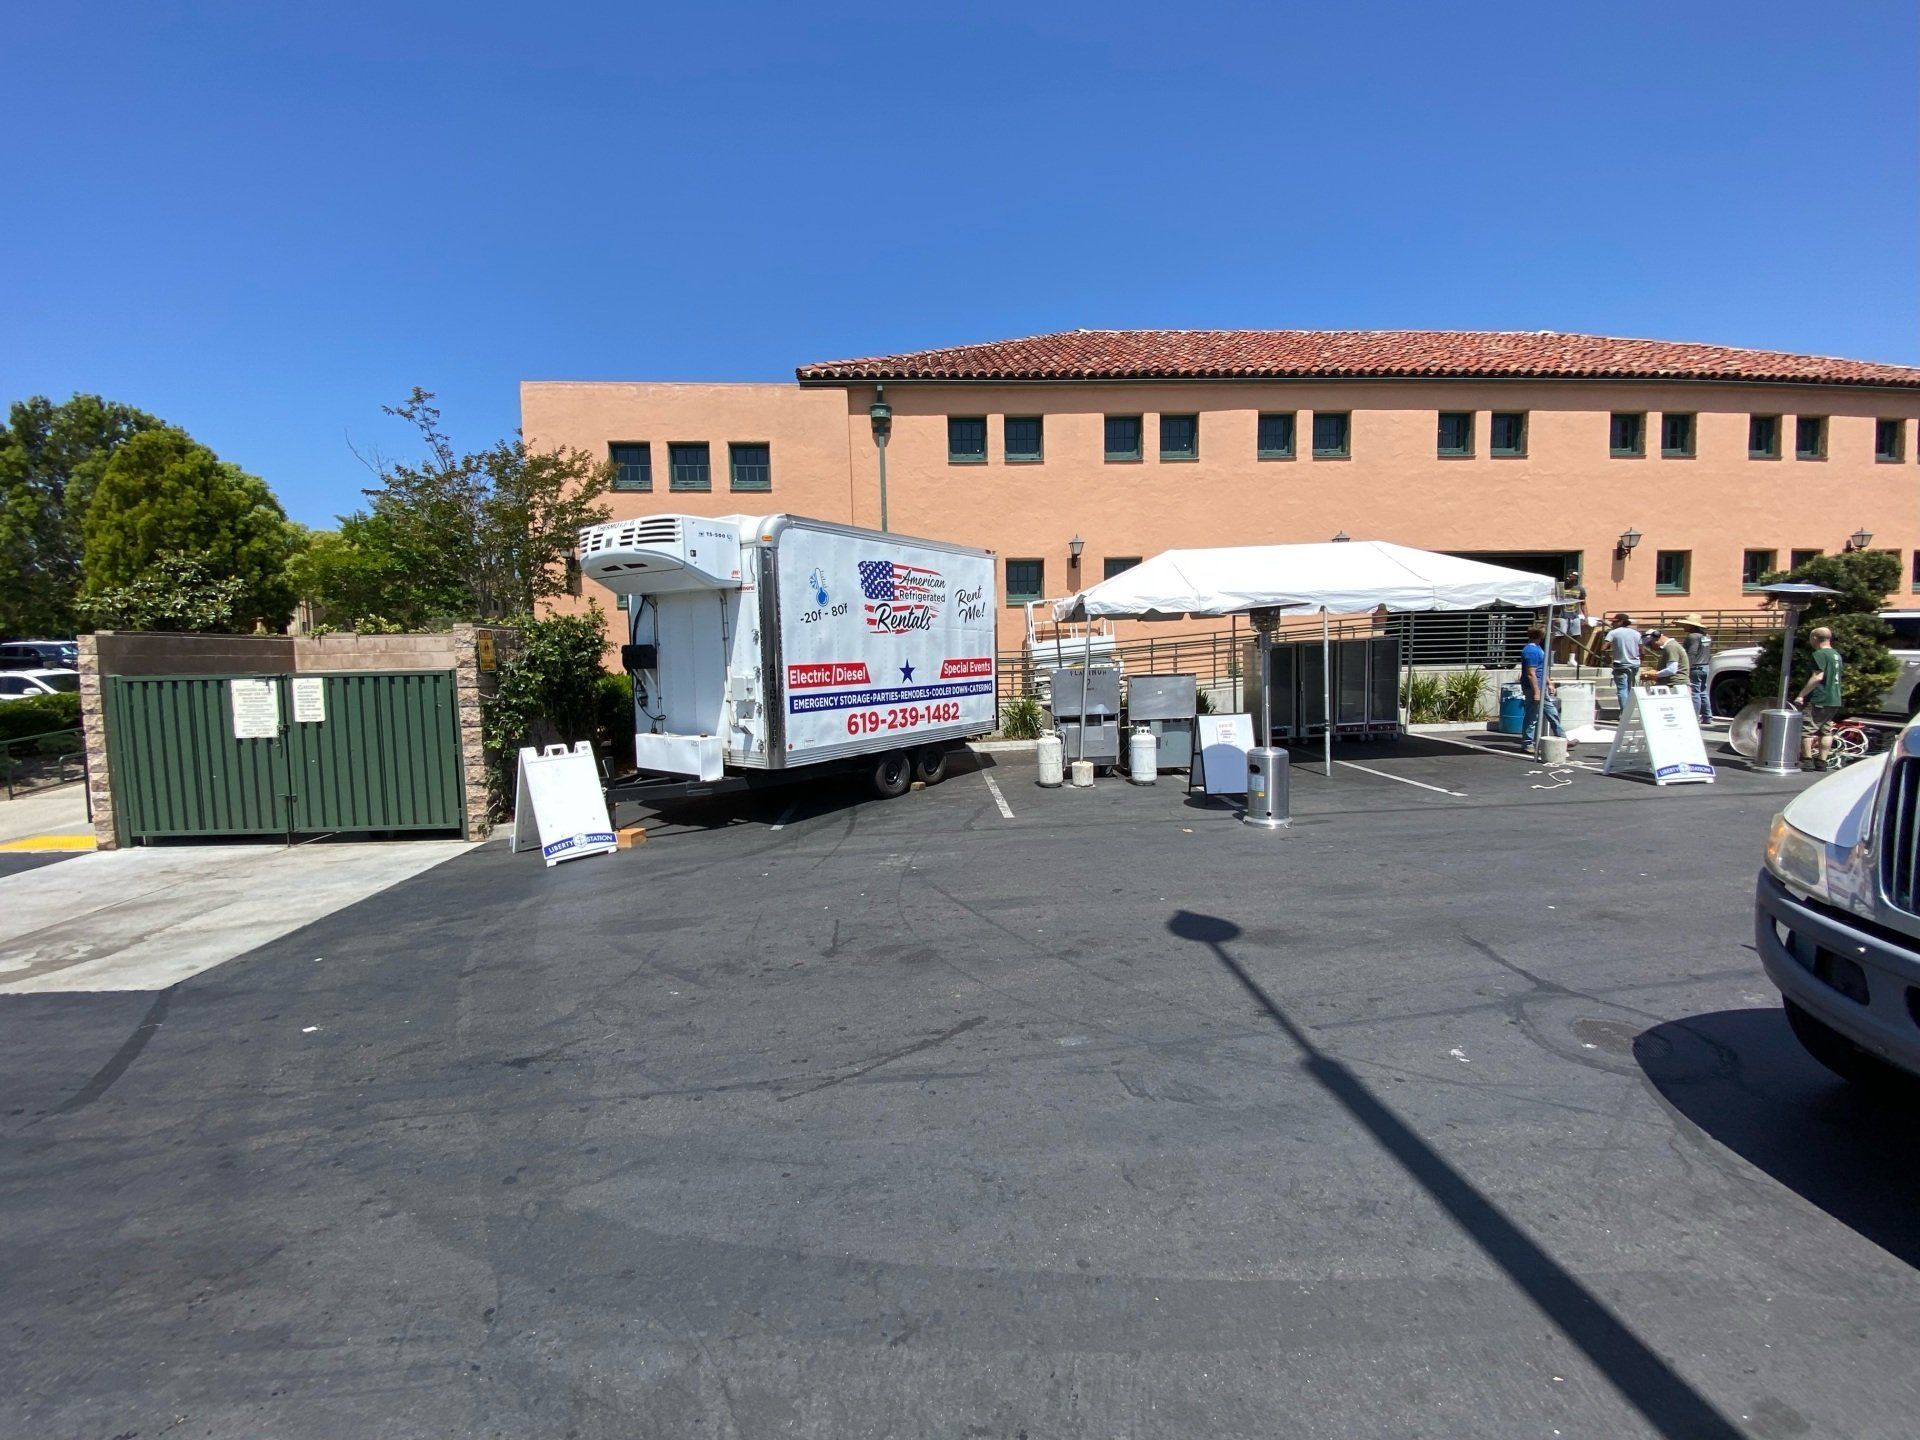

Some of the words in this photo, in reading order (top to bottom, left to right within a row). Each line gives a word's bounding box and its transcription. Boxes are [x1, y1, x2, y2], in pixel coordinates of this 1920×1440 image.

[899, 569, 946, 589] American
[899, 590, 946, 604] Refrigerated
[955, 585, 982, 608] Rent
[800, 611, 822, 625] -20f
[875, 602, 932, 633] Rentals
[958, 602, 986, 624] Me!
[943, 661, 969, 675] Special
[970, 660, 991, 673] Events
[793, 697, 838, 710] EMERGENCY
[847, 702, 960, 735] 619-239-1482
[548, 841, 574, 853] LIBERTY
[586, 834, 613, 843] STATION
